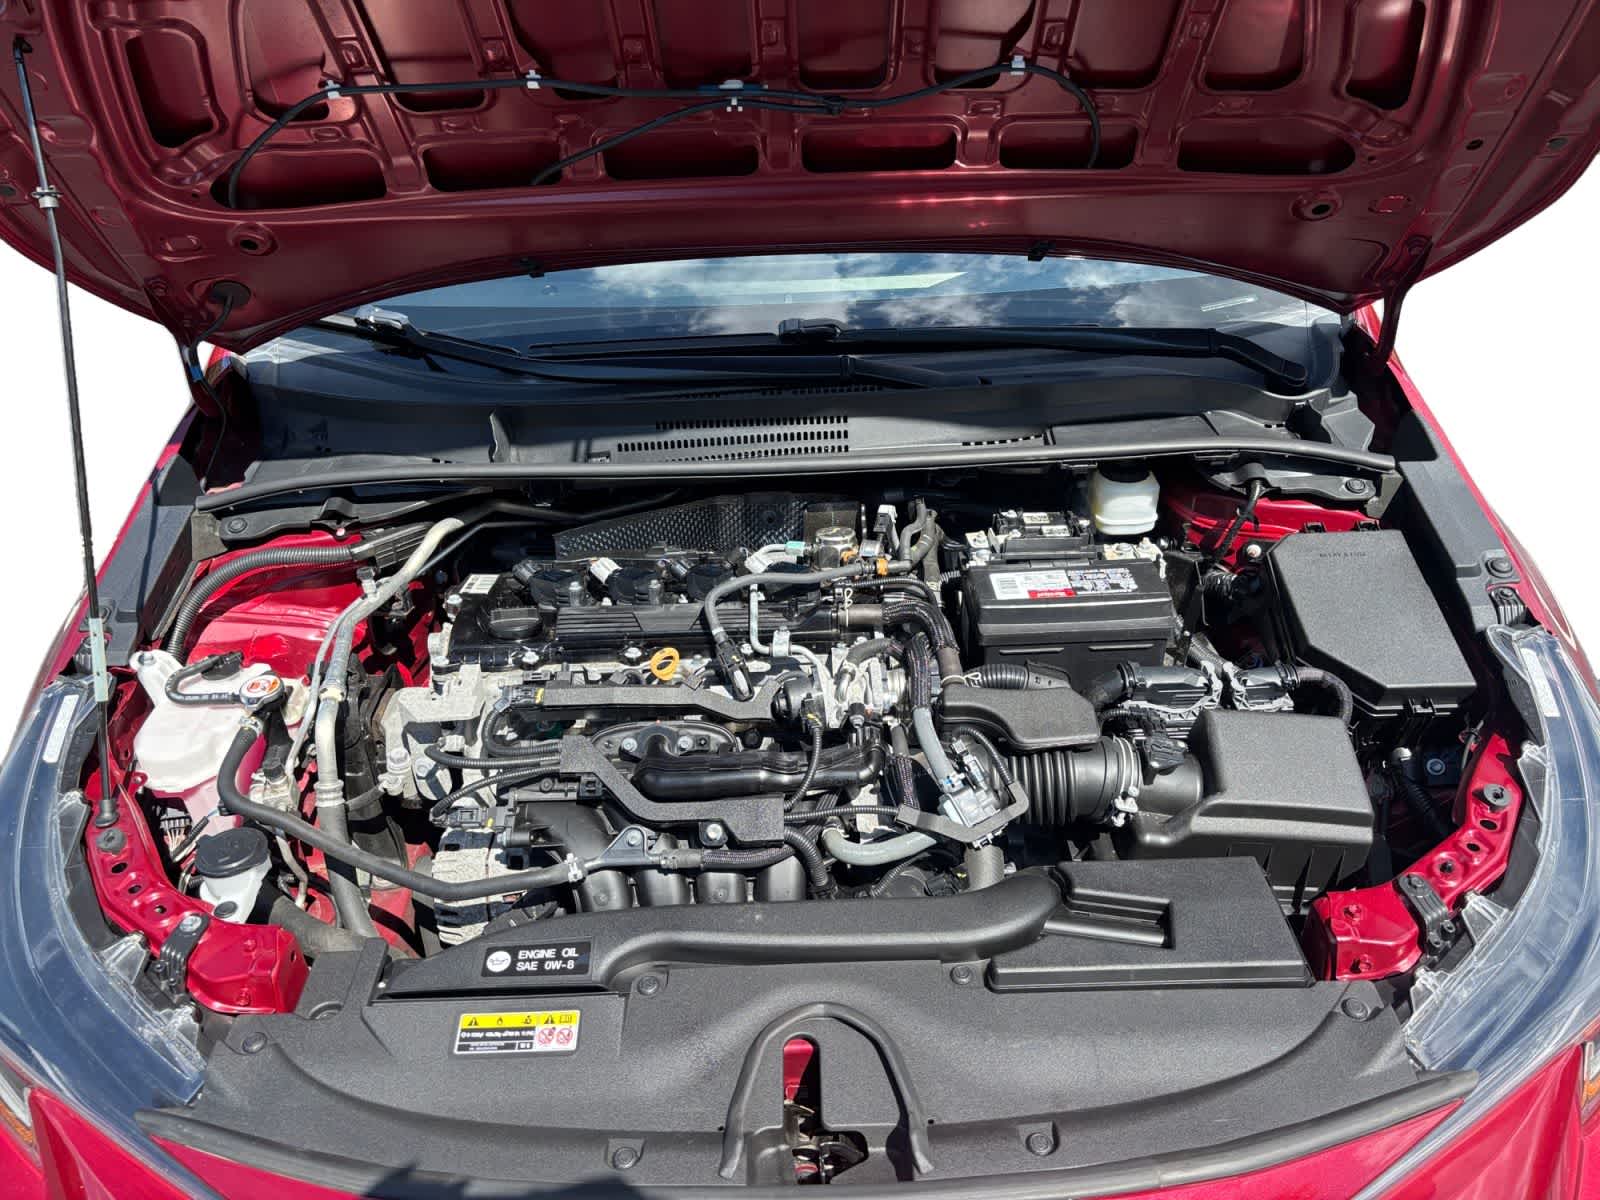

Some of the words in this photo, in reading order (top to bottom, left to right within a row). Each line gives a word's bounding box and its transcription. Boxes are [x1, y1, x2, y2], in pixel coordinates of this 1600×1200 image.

[518, 949, 557, 959] ENGINE
[561, 947, 579, 957] OIL
[516, 961, 539, 971] SAE
[544, 959, 575, 970] 0W-8
